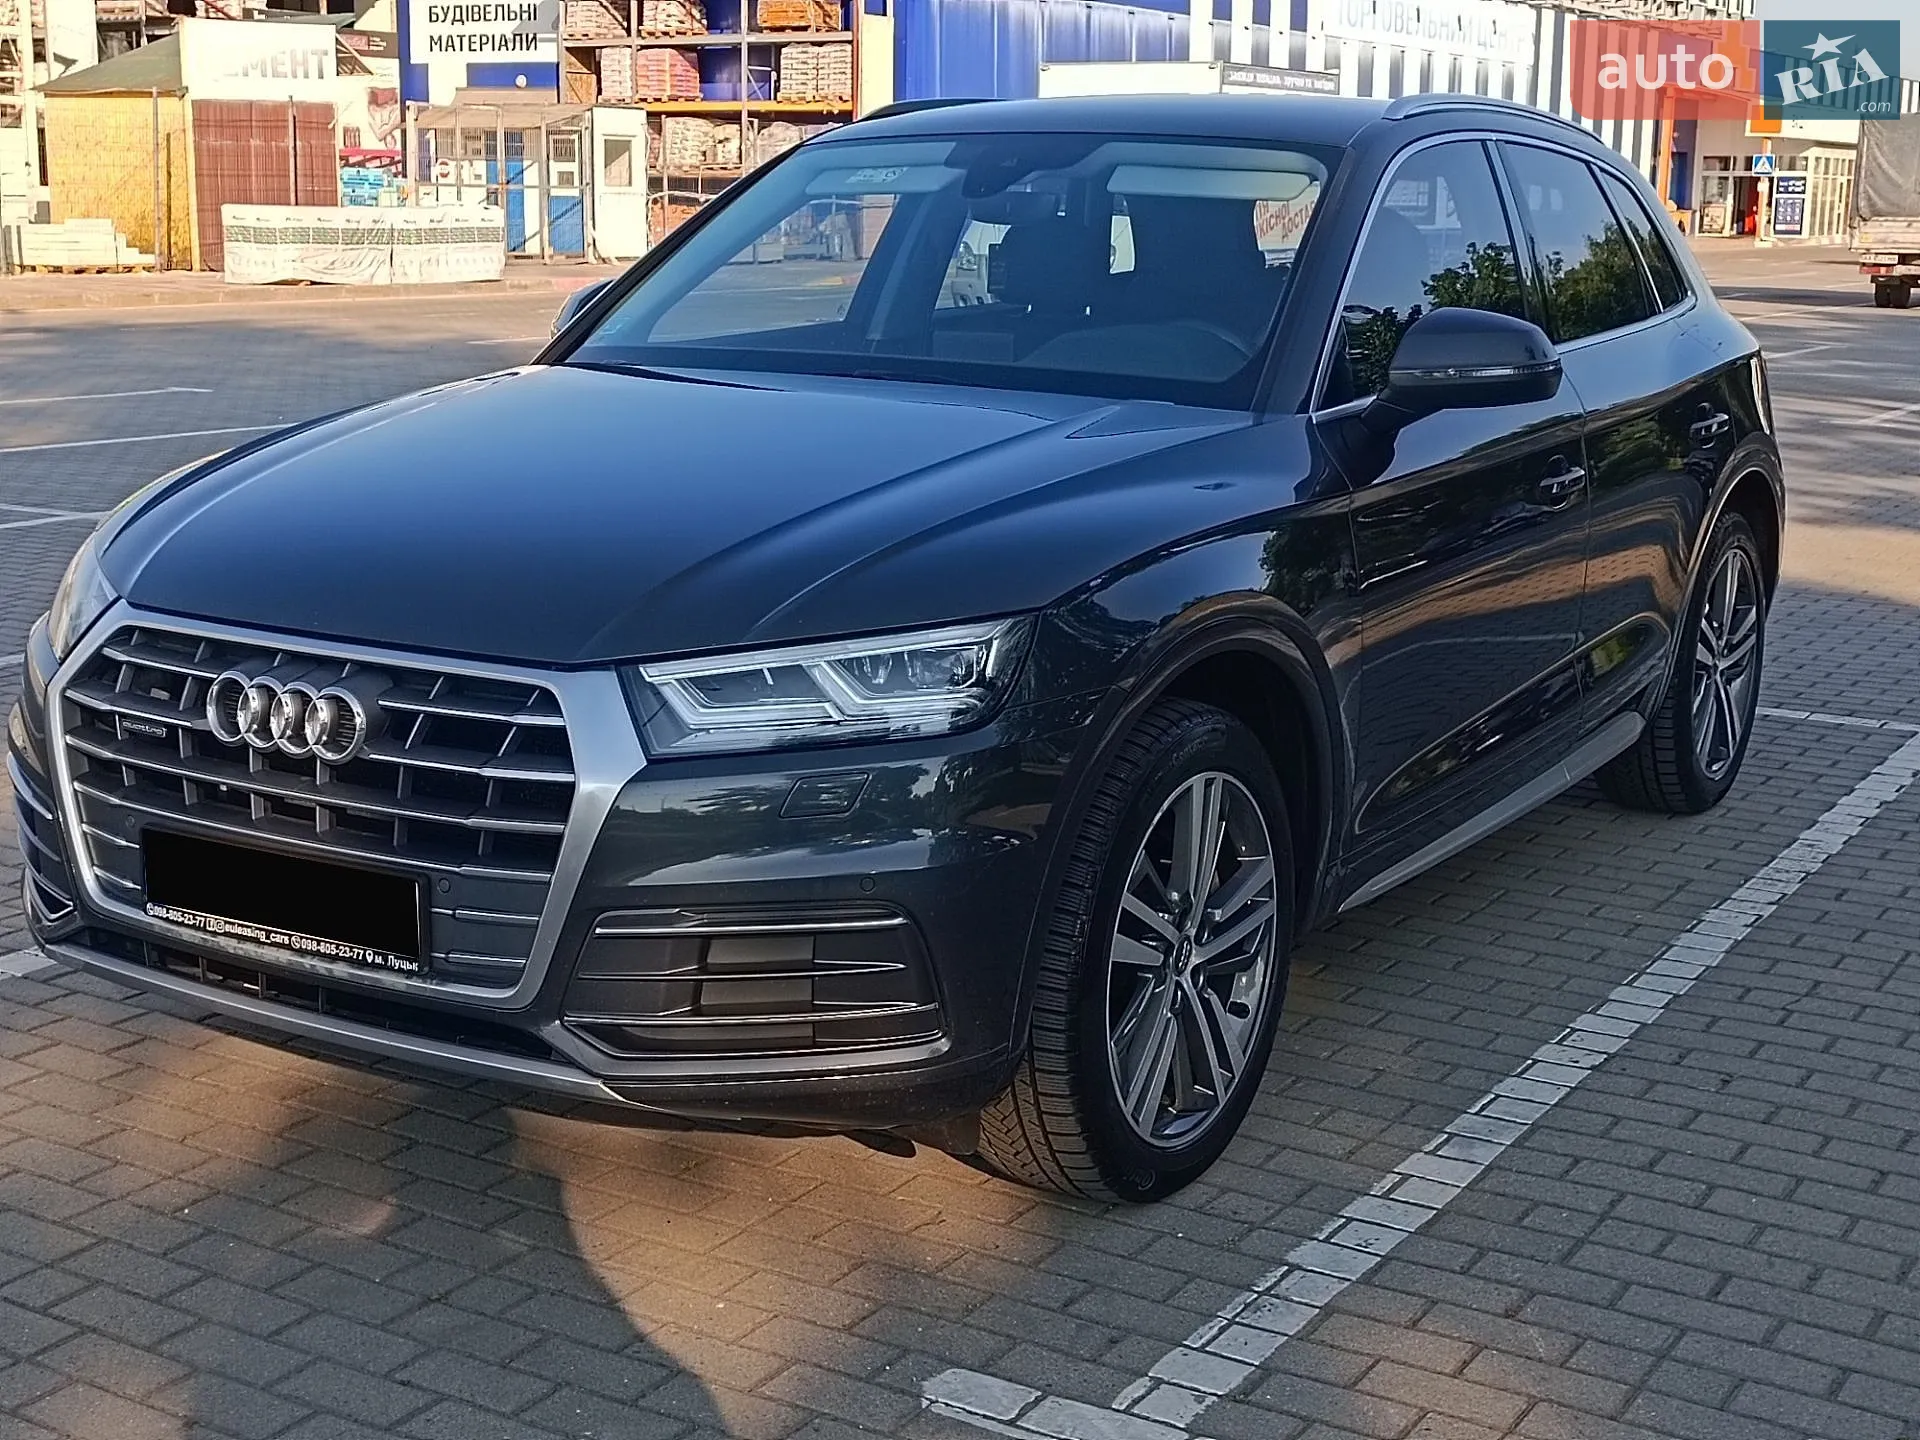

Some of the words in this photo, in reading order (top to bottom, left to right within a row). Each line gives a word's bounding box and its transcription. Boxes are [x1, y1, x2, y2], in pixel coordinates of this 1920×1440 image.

[429, 4, 537, 25] БУДІВЕЛЬНІ
[429, 33, 537, 52] МАТЕРІАЛИ
[225, 924, 290, 945] euleasing_cars
[301, 938, 364, 960] 098-805-23-77
[387, 954, 419, 972] Луцьк
